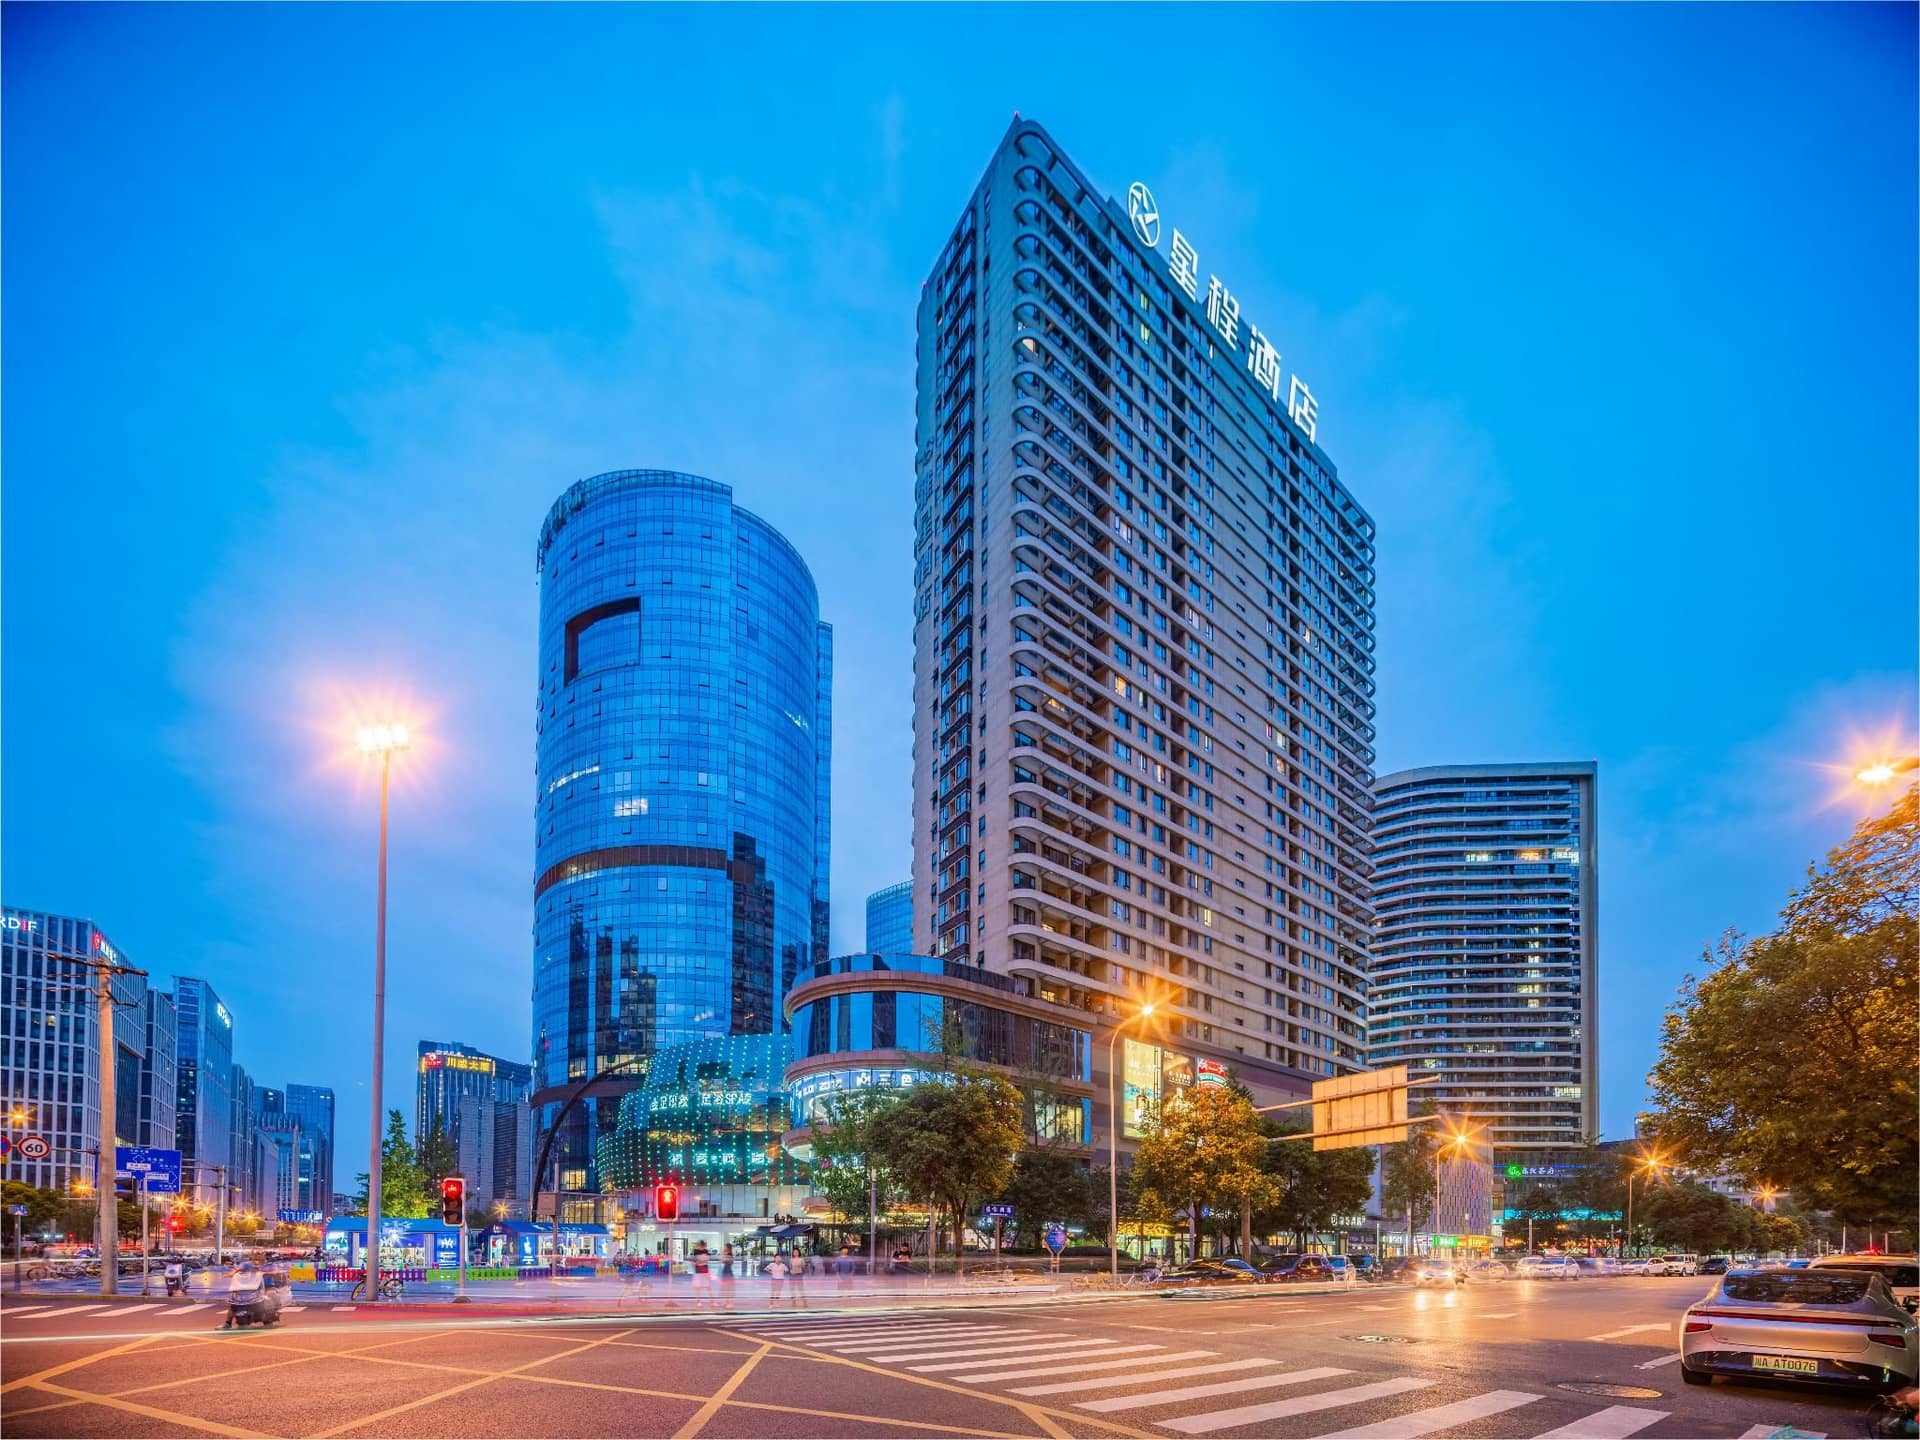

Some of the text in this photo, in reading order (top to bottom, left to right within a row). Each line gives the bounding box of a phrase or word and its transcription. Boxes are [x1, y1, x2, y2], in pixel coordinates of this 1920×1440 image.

[1168, 227, 1319, 444] 星程酒店
[25, 1143, 43, 1154] 60
[1773, 1358, 1816, 1371] AT0076
